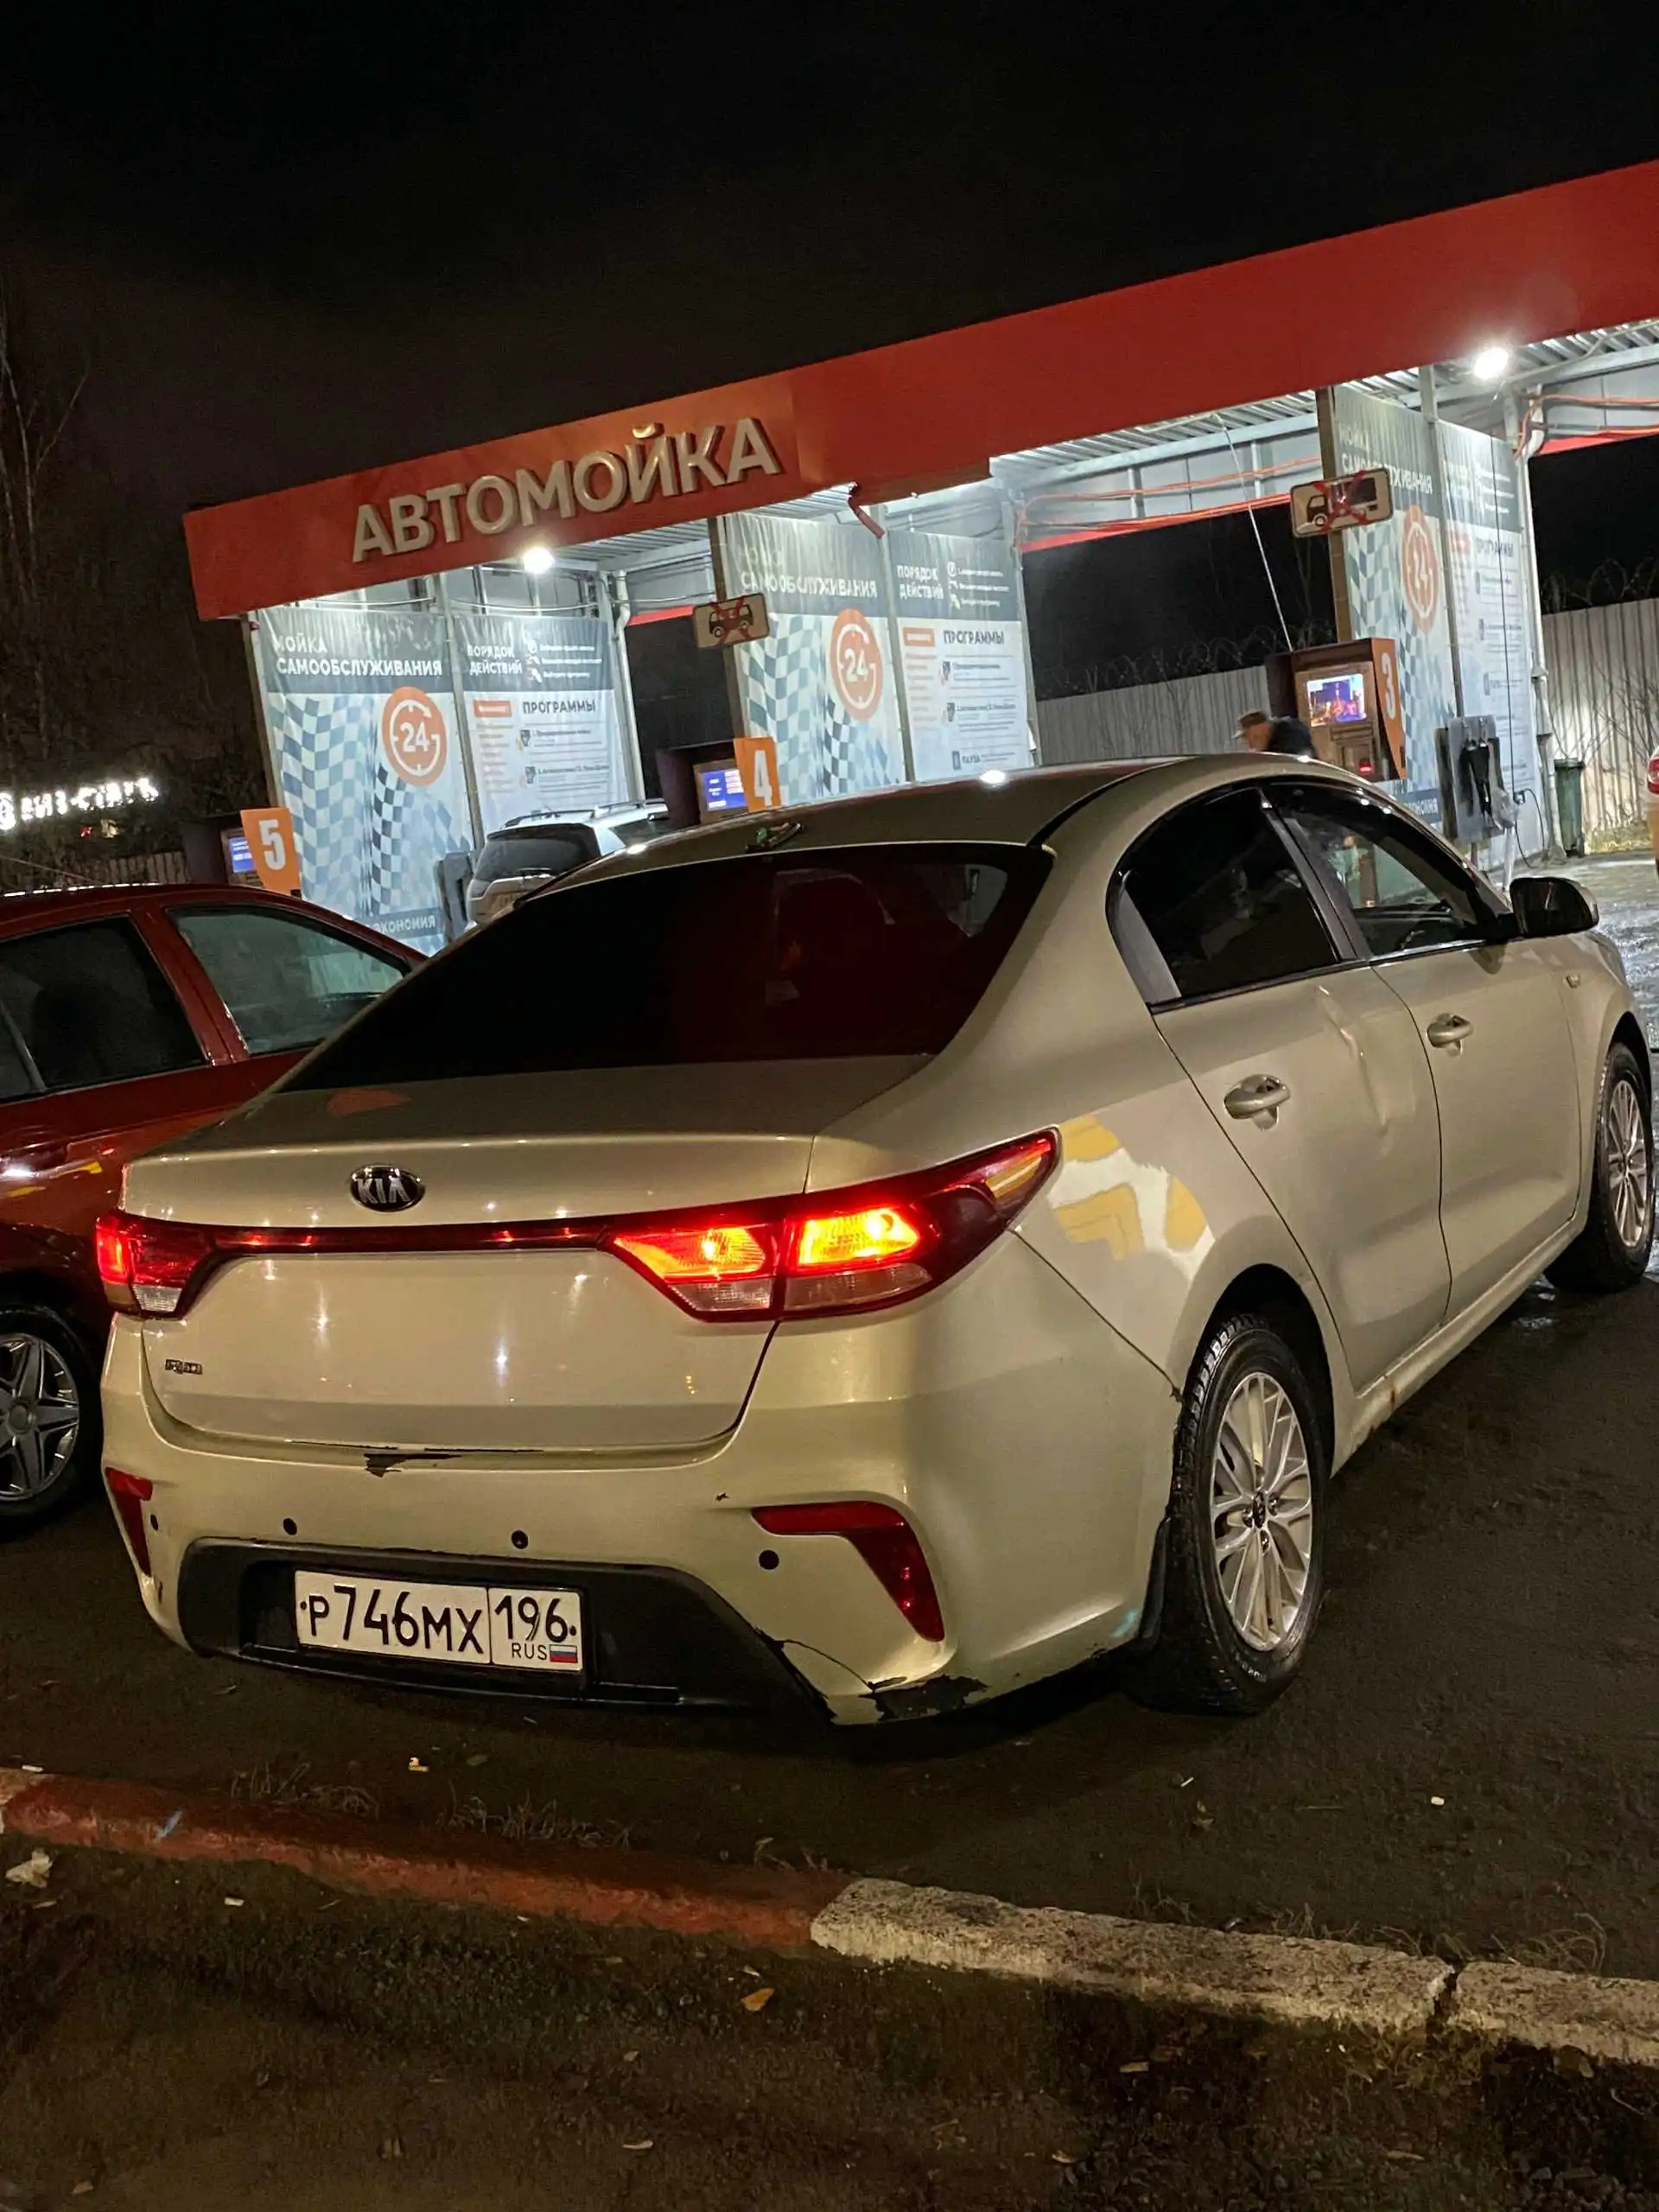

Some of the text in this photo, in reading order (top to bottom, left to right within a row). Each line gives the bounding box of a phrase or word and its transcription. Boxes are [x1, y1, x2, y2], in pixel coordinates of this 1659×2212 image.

[352, 417, 781, 563] АВТОМОЙКА
[944, 630, 1004, 645] ПРОГРАММЫ
[276, 658, 442, 676] САМООБСЛУЖИВАНИЯ
[469, 659, 523, 676] ДЕЙСТВИЙ
[844, 648, 868, 683] 24
[1381, 652, 1395, 719] 3
[522, 699, 596, 715] ПРОГРАММЫ
[400, 721, 430, 753] 24
[754, 750, 772, 805] 4
[259, 819, 286, 871] 5
[357, 1178, 410, 1205] KIA
[494, 1595, 569, 1643] 196
[512, 1643, 548, 1661] RUS
